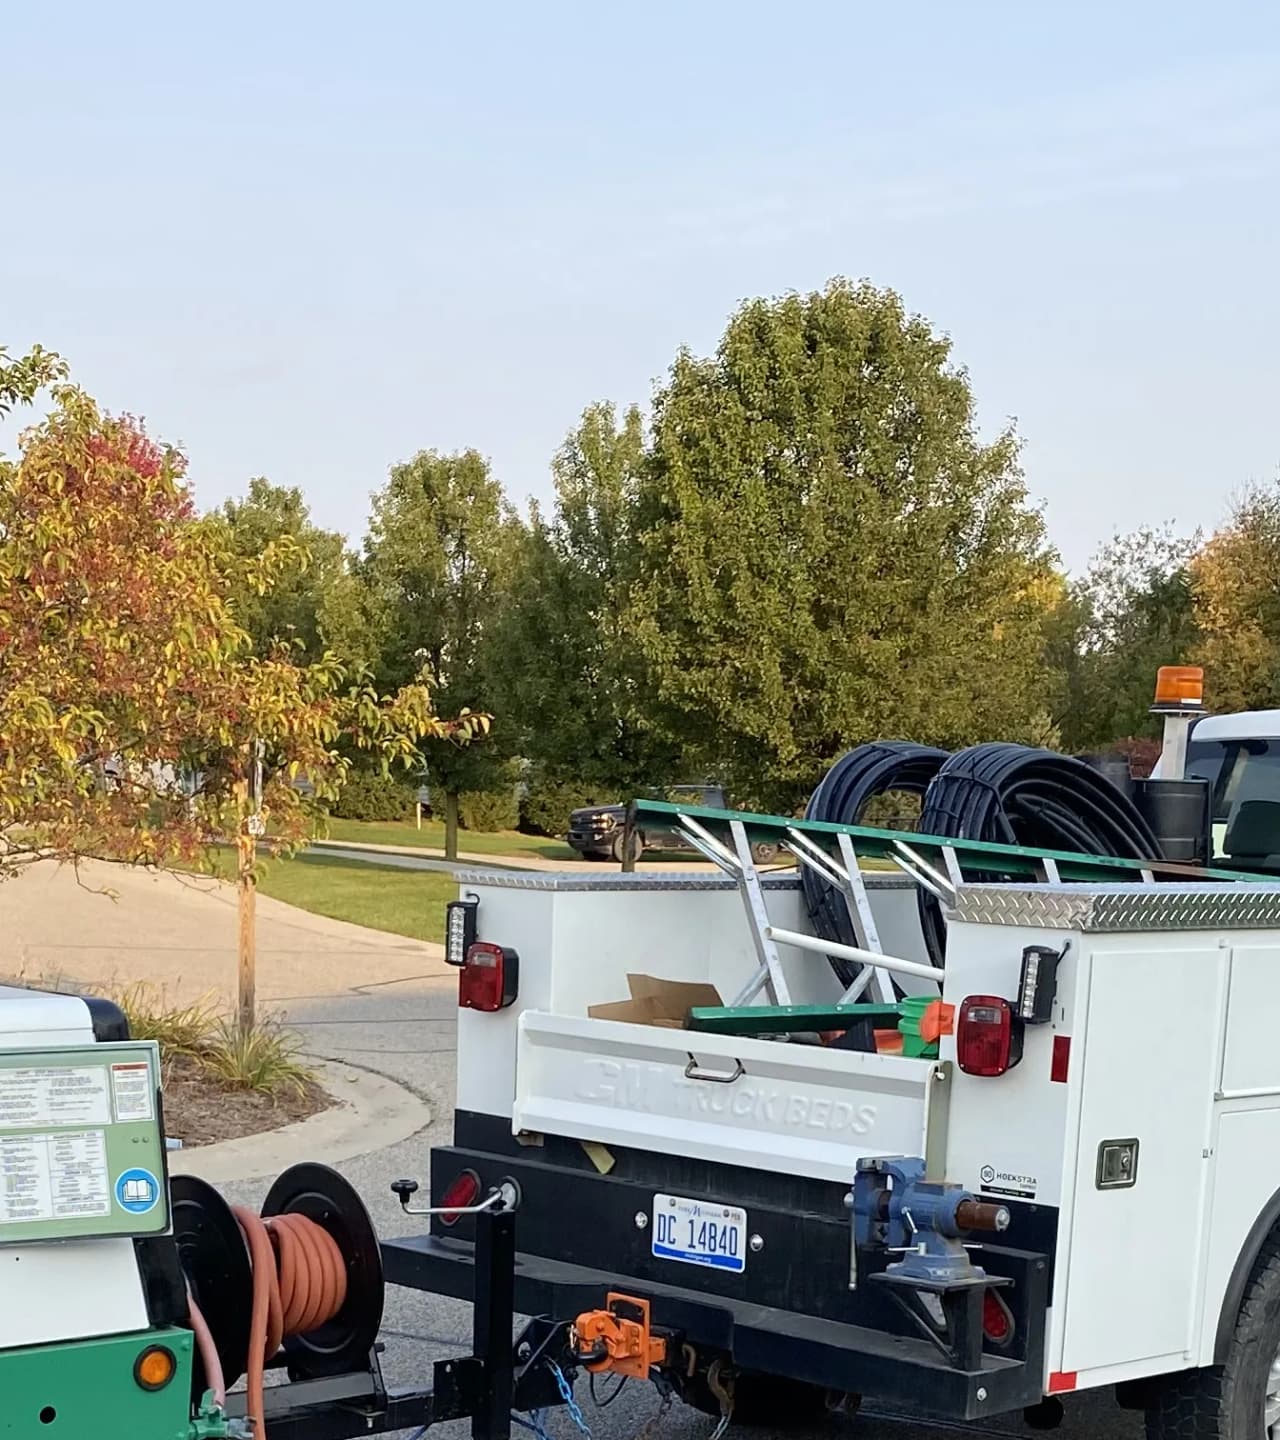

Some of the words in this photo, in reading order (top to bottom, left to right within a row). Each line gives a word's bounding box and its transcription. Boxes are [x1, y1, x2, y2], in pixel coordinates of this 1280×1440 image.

[672, 1076, 775, 1122] TRUCK
[783, 1095, 879, 1136] BEDS
[658, 1213, 677, 1245] DC
[687, 1218, 738, 1256] 14840
